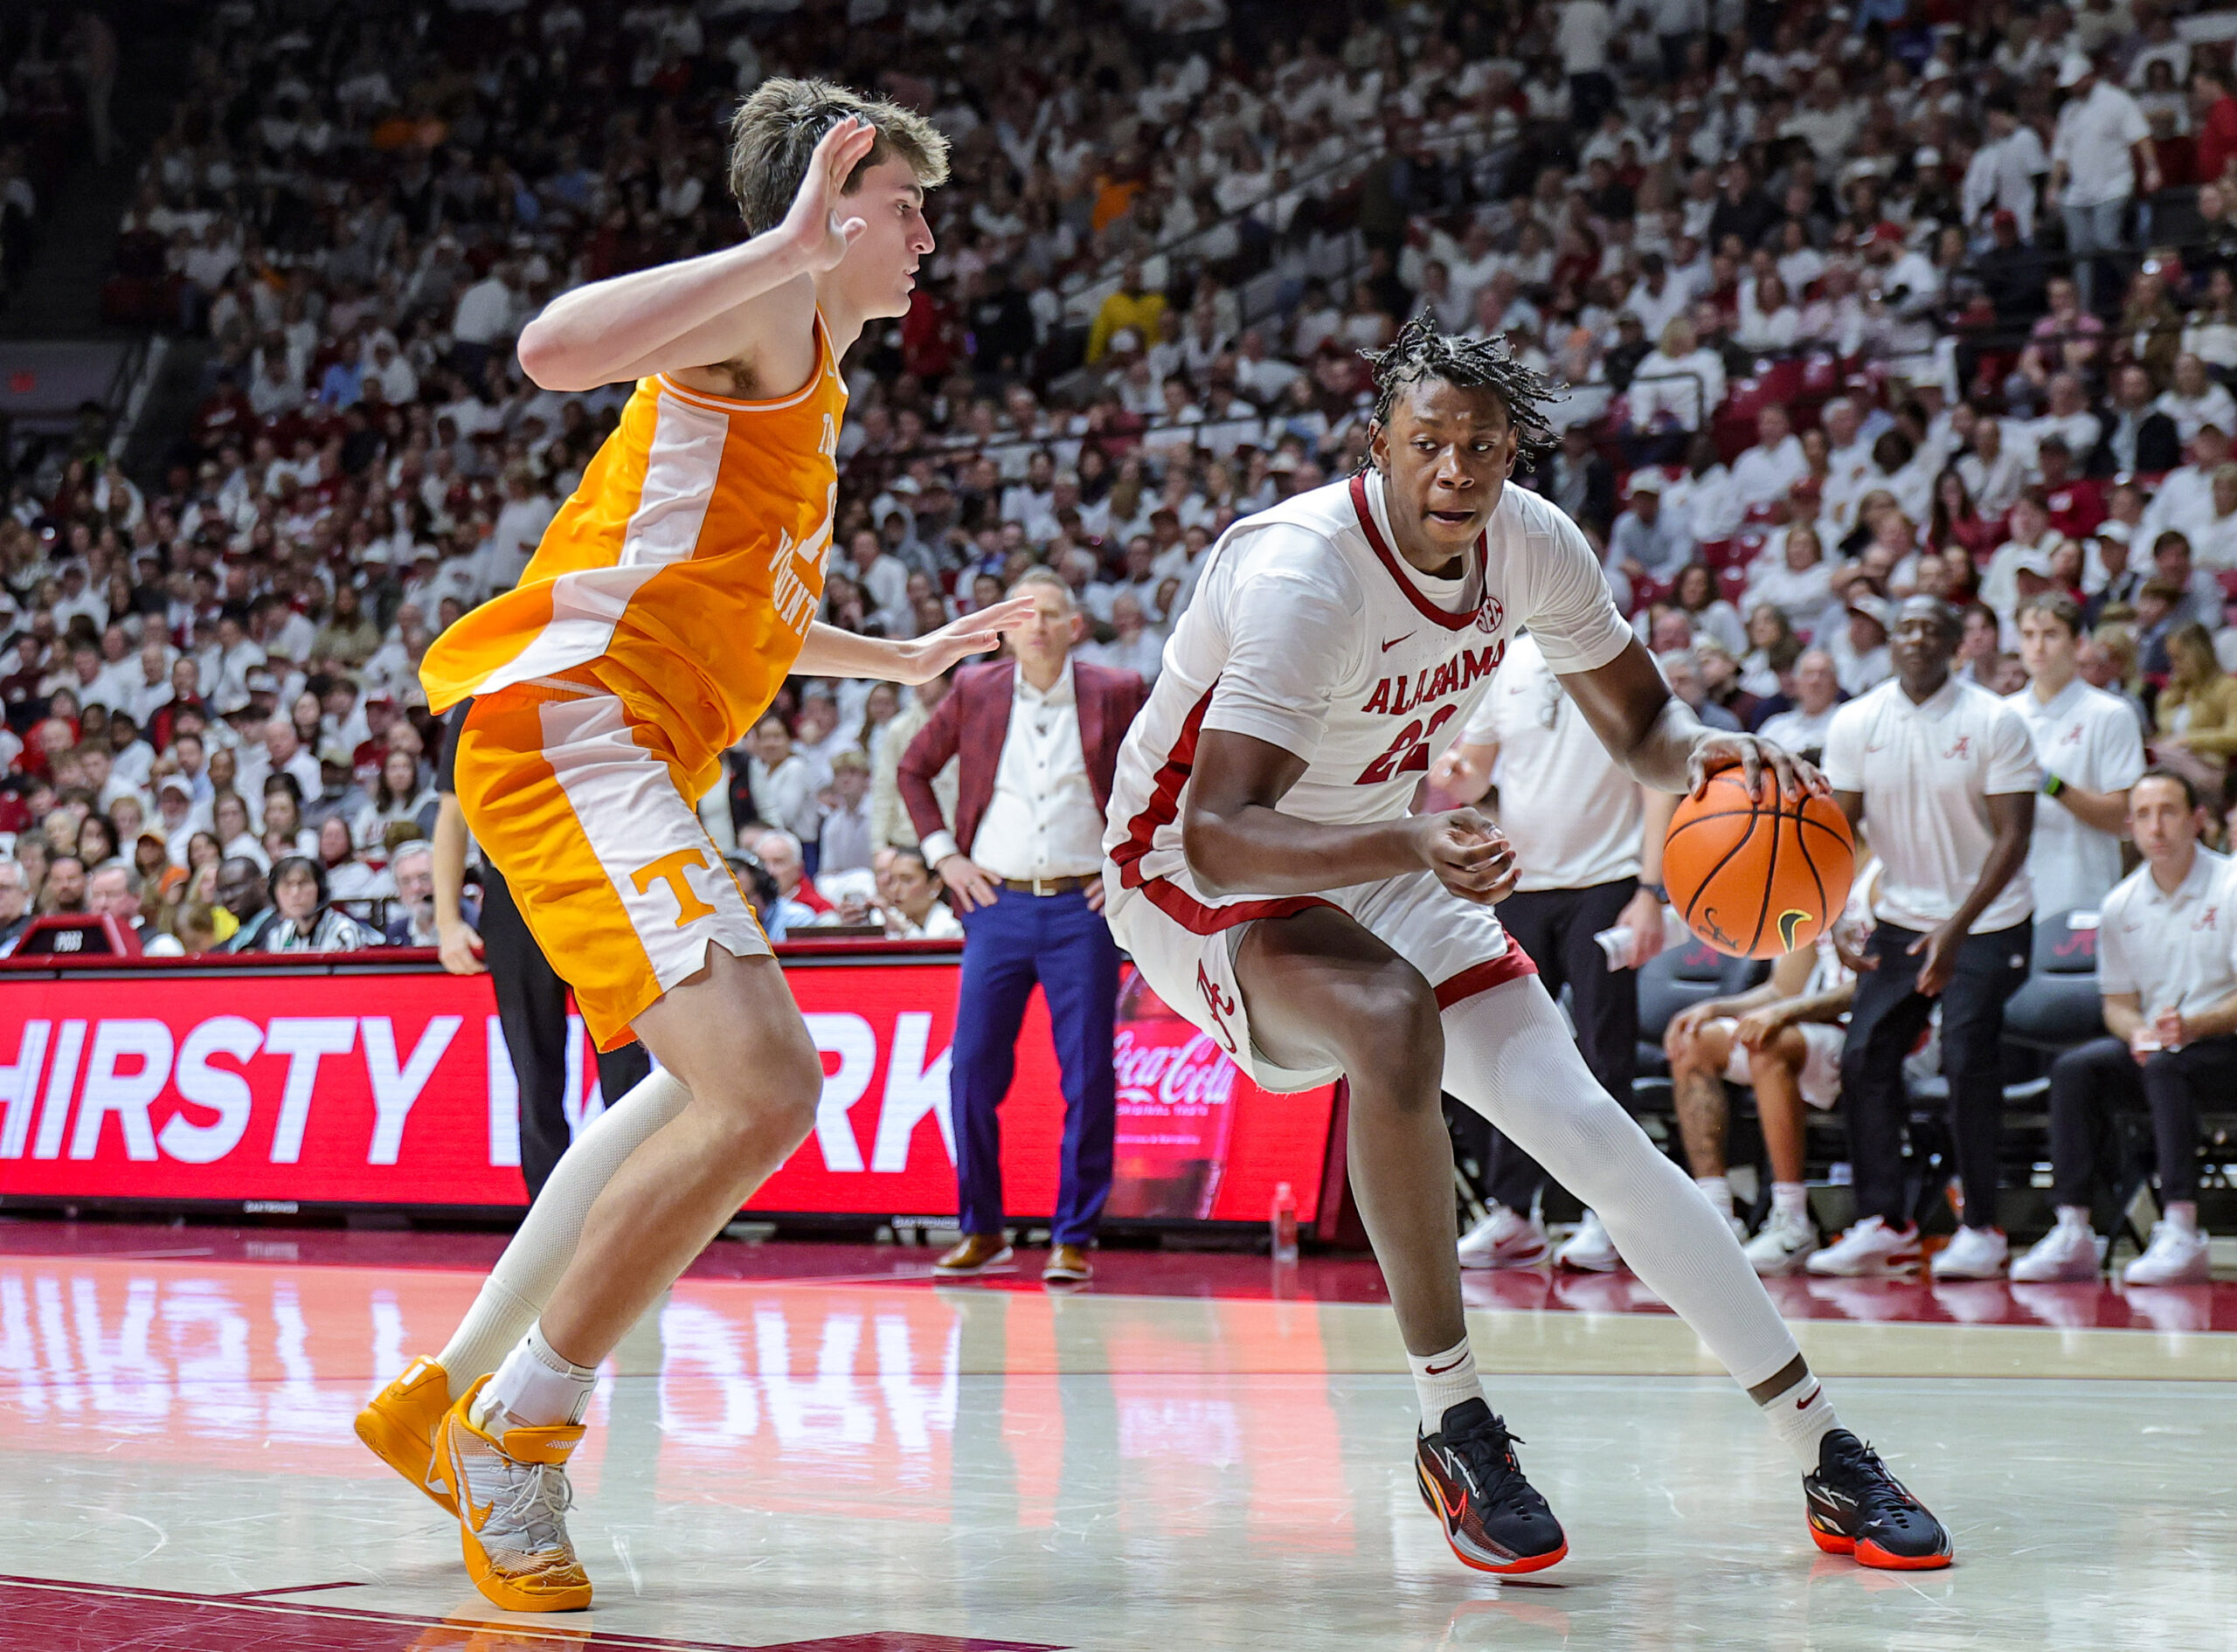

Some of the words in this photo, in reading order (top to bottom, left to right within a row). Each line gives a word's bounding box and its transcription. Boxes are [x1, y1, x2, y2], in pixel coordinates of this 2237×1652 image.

[1477, 598, 1503, 632] SEC
[1361, 639, 1505, 715] ALABAMA
[1353, 703, 1458, 785] 22
[629, 848, 717, 929] T
